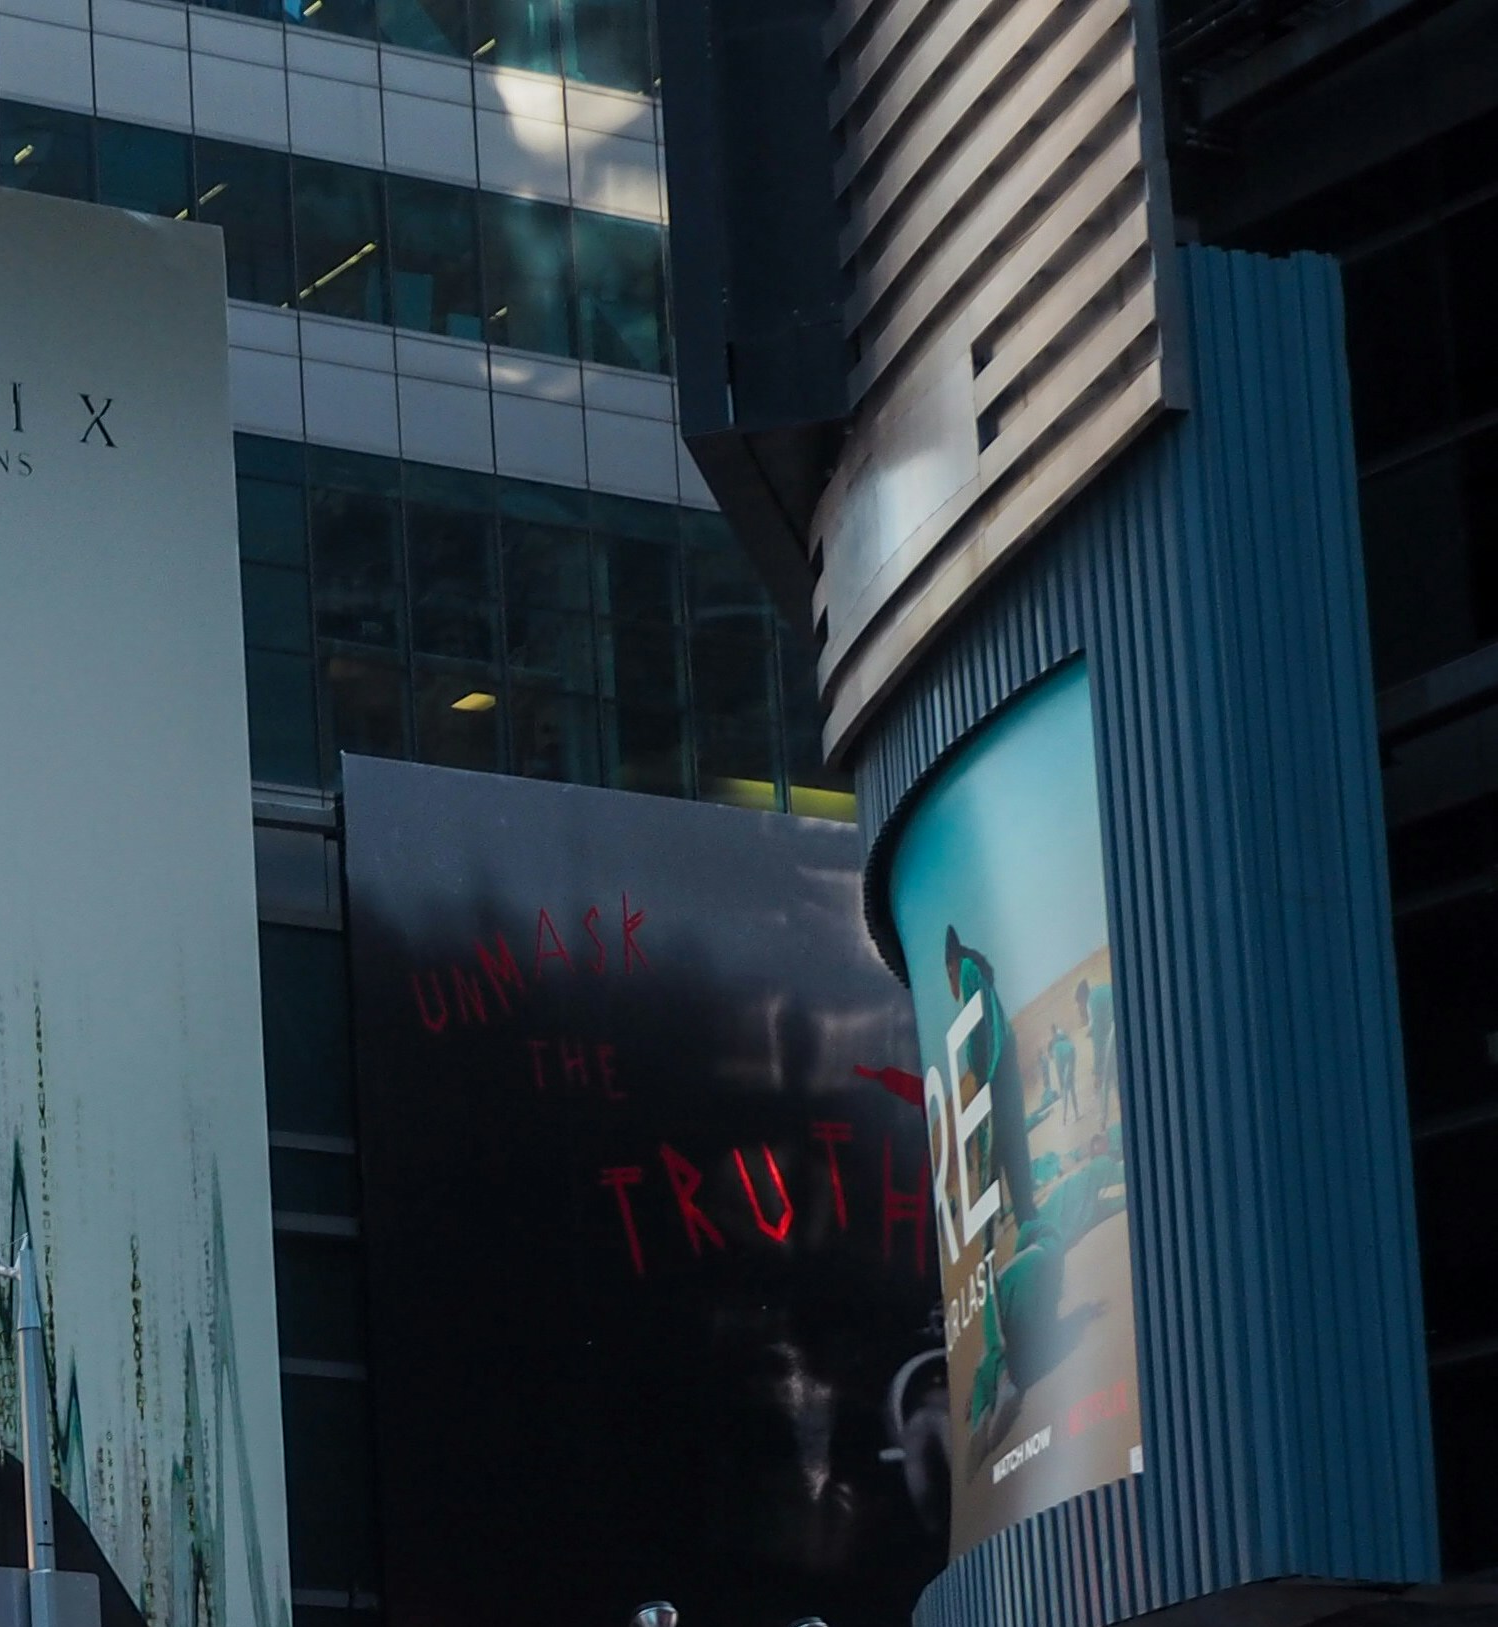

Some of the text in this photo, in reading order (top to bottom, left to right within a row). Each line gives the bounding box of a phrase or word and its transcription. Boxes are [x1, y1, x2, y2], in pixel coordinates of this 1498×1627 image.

[411, 892, 651, 1034] UNMASK
[602, 1121, 933, 1280] TRUTH
[960, 1249, 996, 1329] LAST
[1025, 1425, 1052, 1462] NOW
